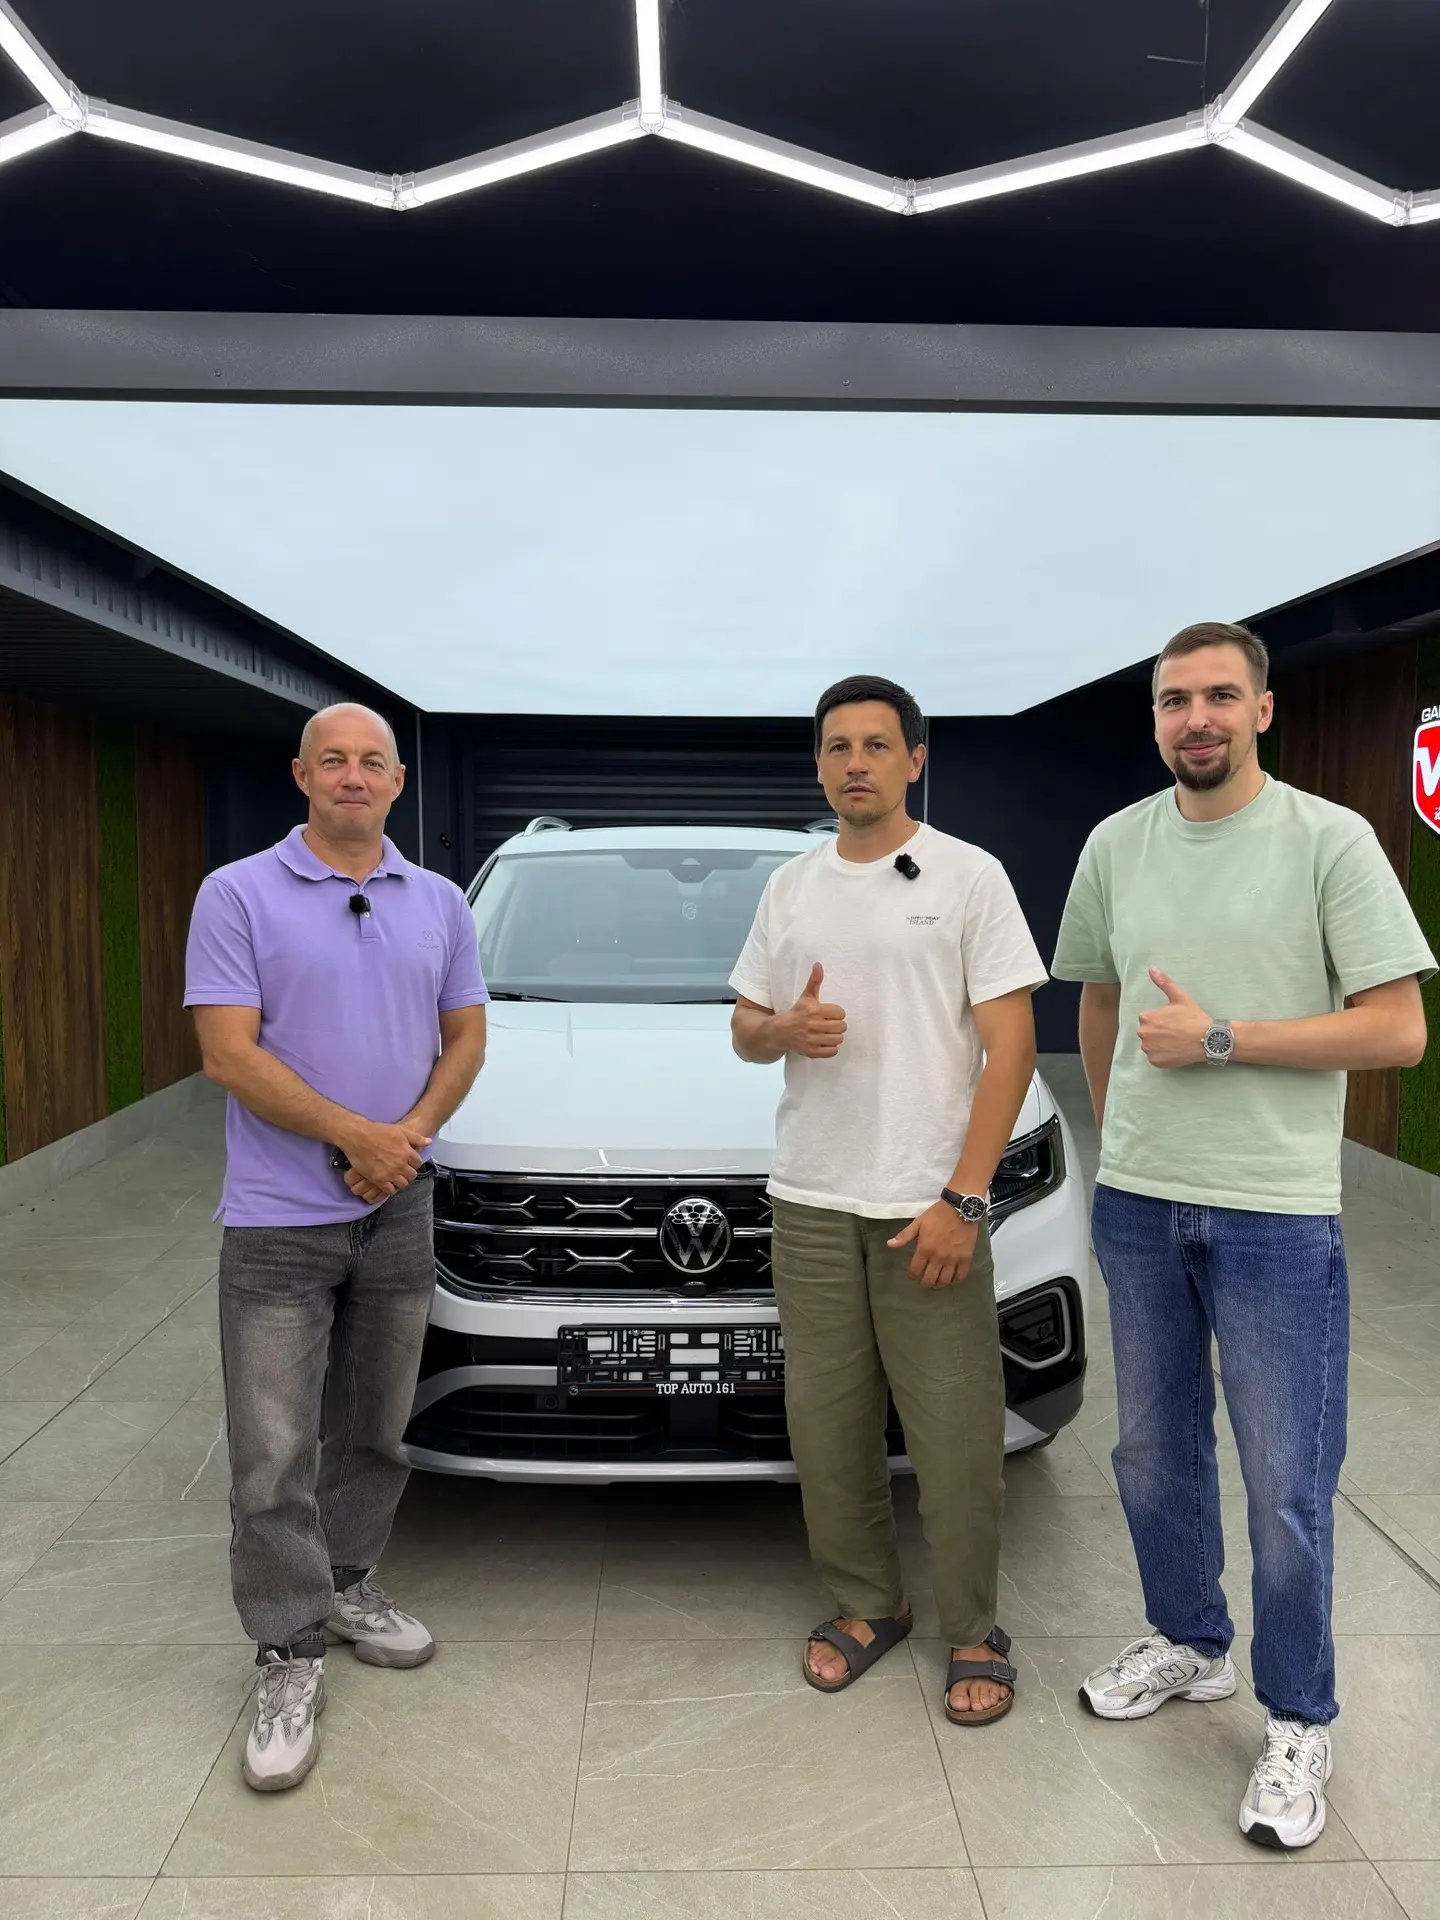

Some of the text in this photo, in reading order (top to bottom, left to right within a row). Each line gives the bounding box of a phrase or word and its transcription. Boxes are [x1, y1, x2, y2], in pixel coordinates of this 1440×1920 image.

[655, 1382, 736, 1395] TOP AUTO 161
